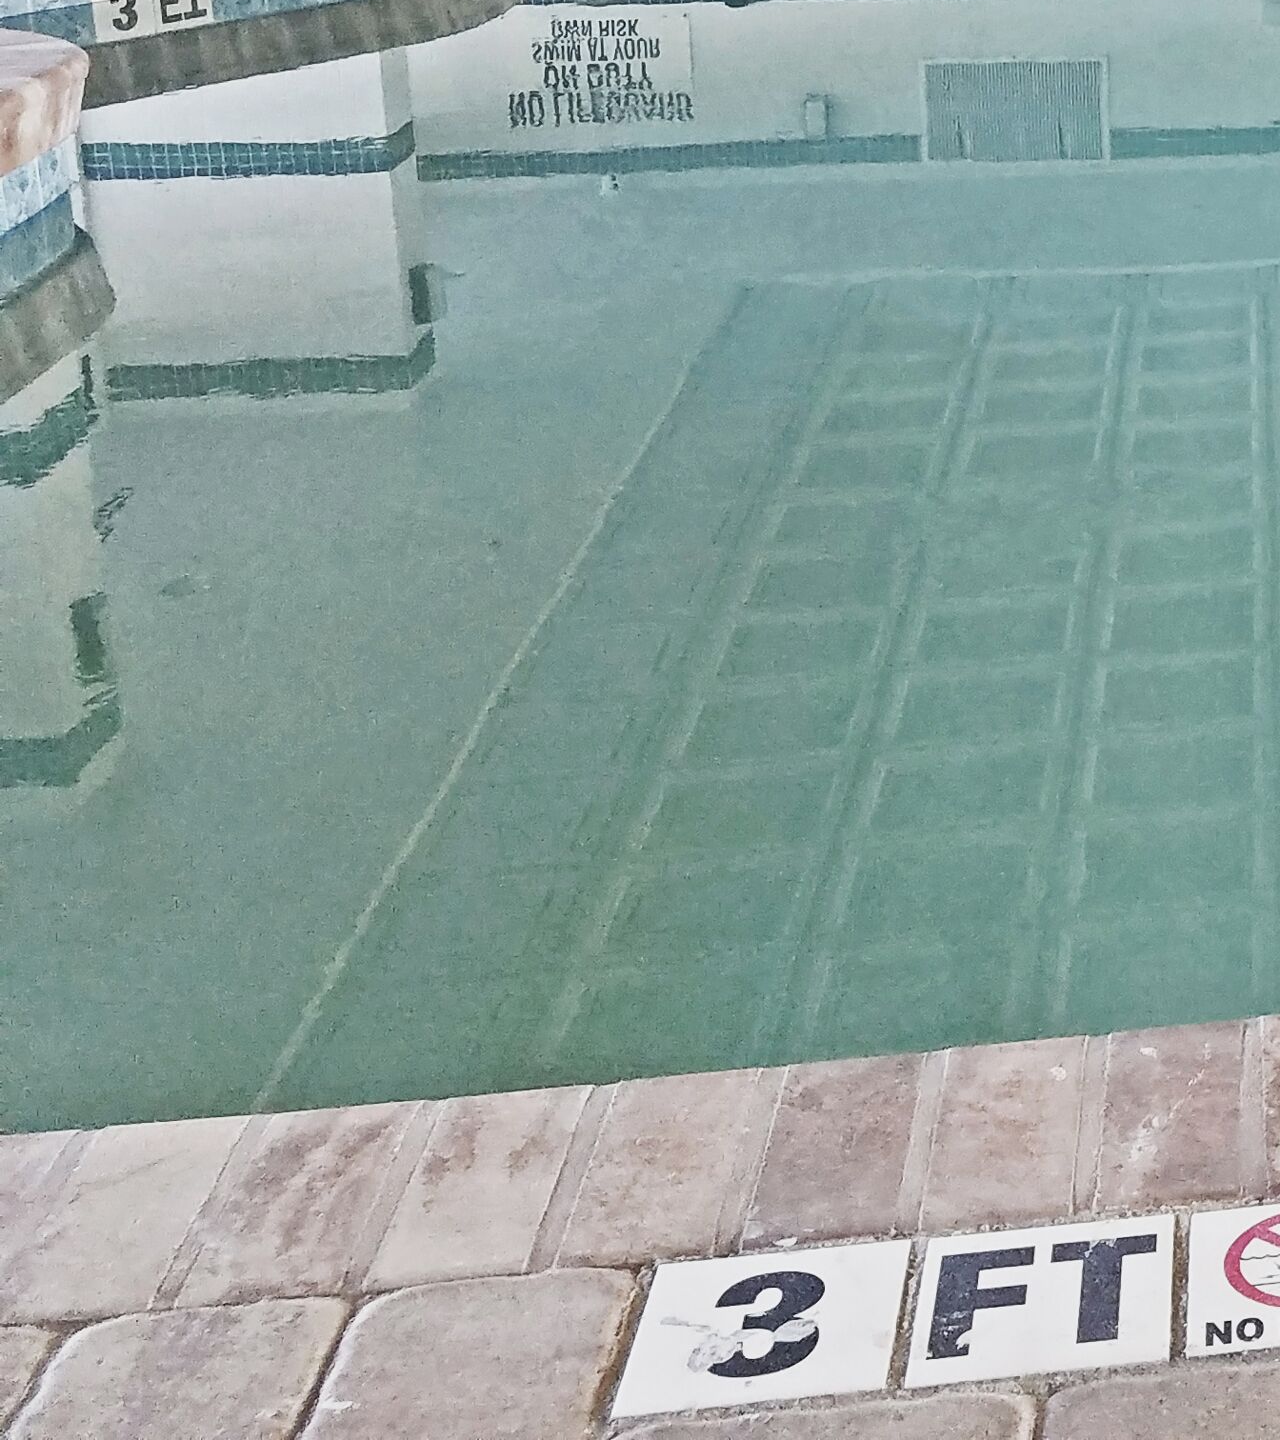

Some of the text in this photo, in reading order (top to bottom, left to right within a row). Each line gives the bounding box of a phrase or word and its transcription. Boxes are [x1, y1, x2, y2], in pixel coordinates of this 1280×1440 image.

[707, 1233, 1157, 1377] 3 FT
[1205, 1317, 1264, 1347] NO
